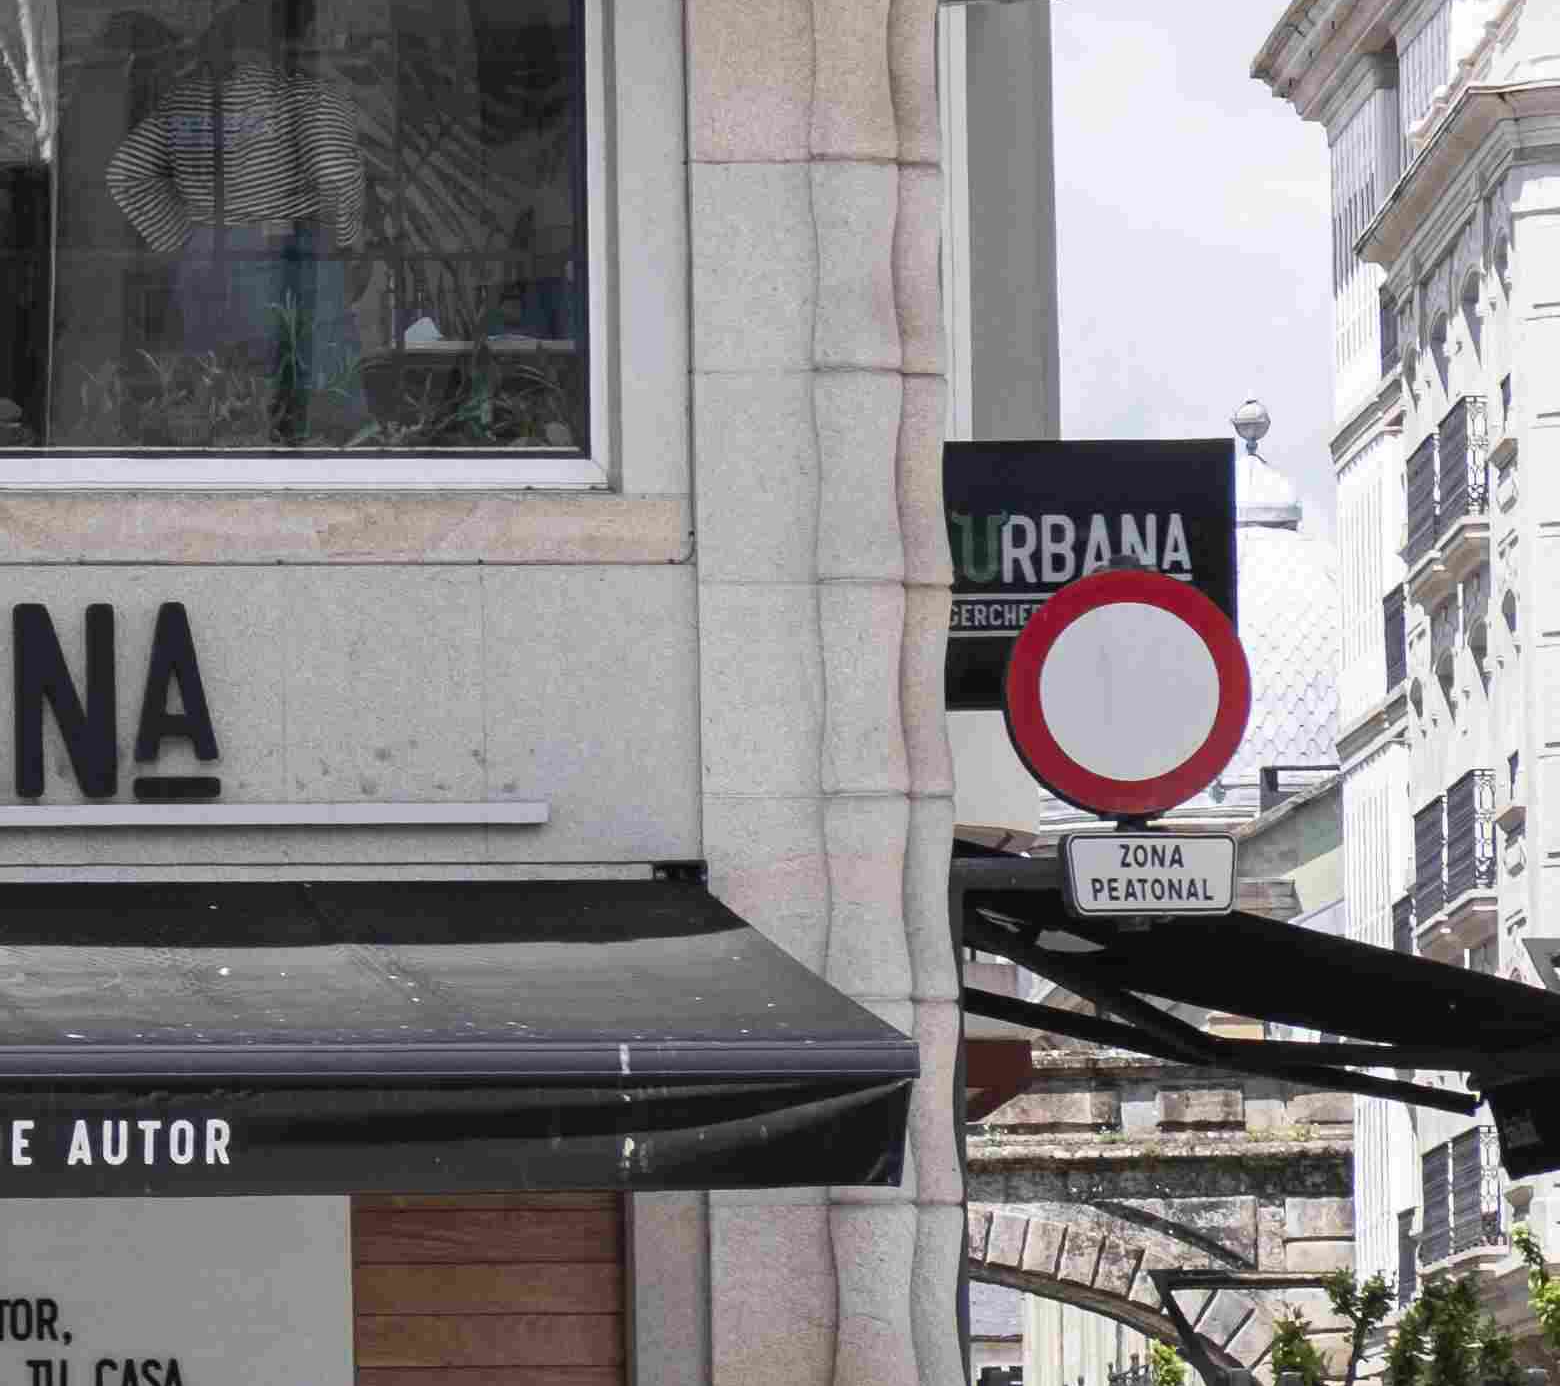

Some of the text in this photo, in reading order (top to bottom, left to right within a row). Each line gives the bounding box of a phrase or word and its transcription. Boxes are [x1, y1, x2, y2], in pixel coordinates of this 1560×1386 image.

[1118, 844, 1185, 868] ZONA
[1090, 878, 1215, 902] PEATONAL
[67, 1118, 233, 1166] AUTOR
